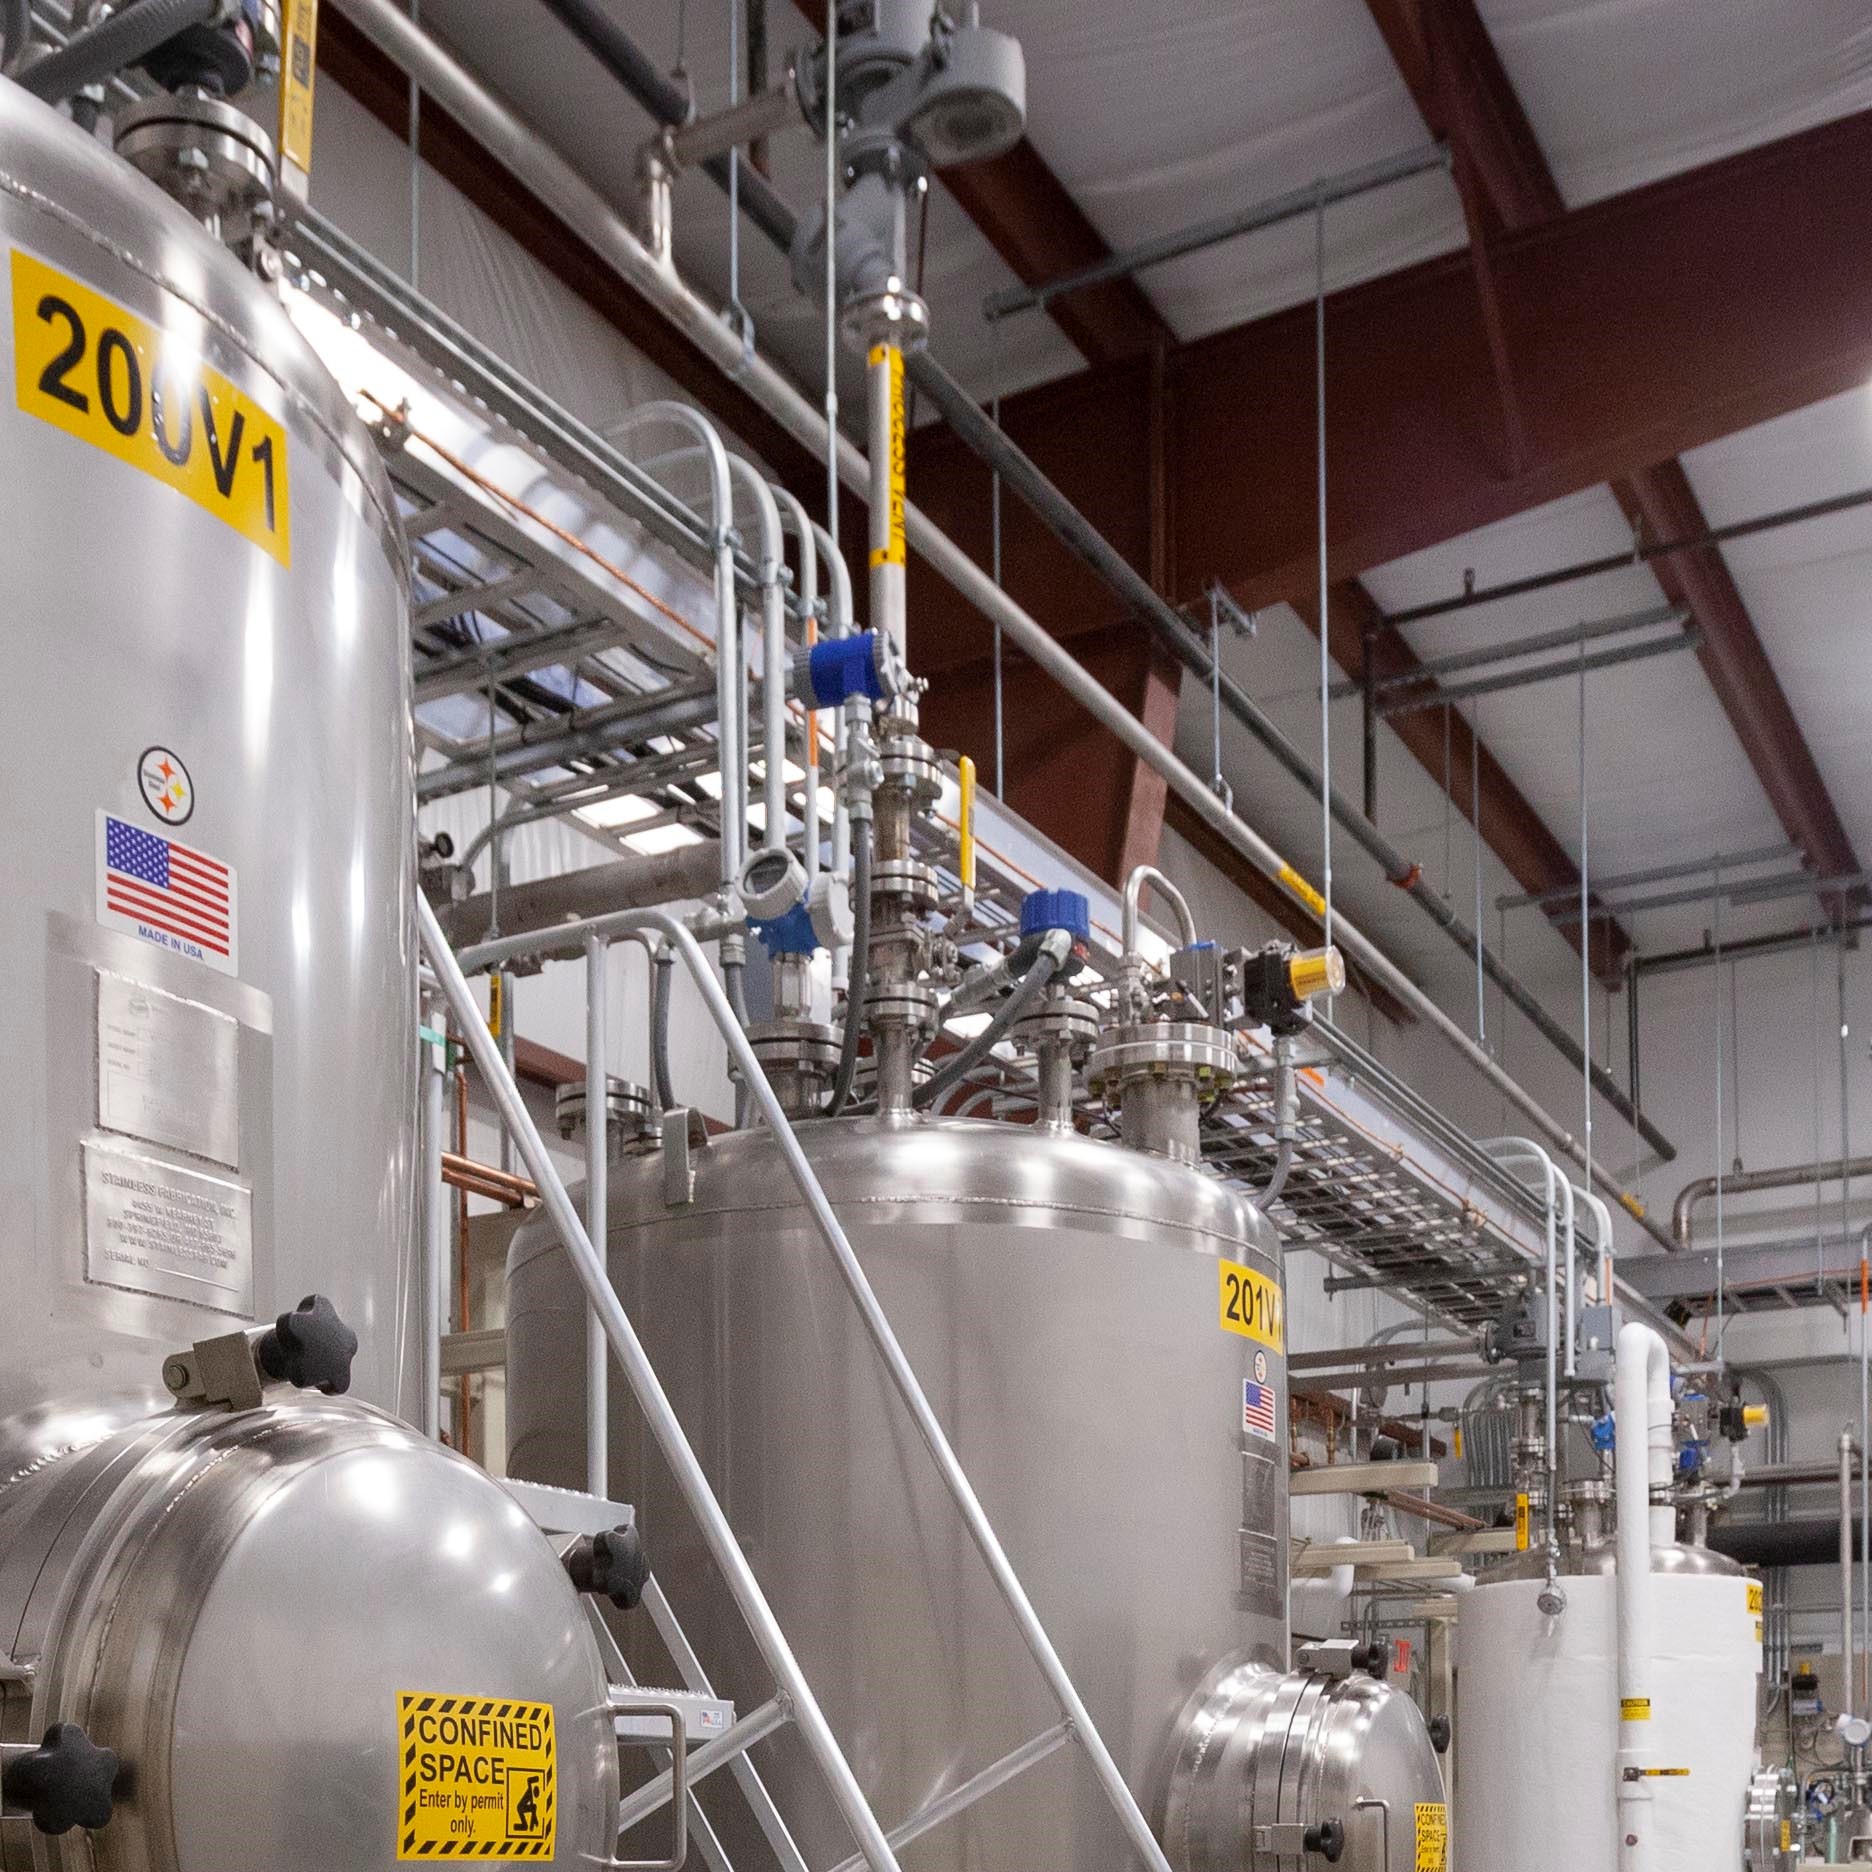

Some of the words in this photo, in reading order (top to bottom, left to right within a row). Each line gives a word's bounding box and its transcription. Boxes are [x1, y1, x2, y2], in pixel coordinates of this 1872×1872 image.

[36, 293, 276, 534] 200V1
[137, 924, 169, 947] MADE
[170, 936, 181, 951] IN
[182, 940, 204, 961] USA
[101, 1172, 156, 1195] STAINLESS
[418, 1715, 543, 1751] CONFINED
[419, 1753, 505, 1785] SPACE
[419, 1789, 451, 1809] Enter
[454, 1790, 468, 1813] by
[471, 1791, 505, 1813] permit
[450, 1815, 476, 1838] only.
